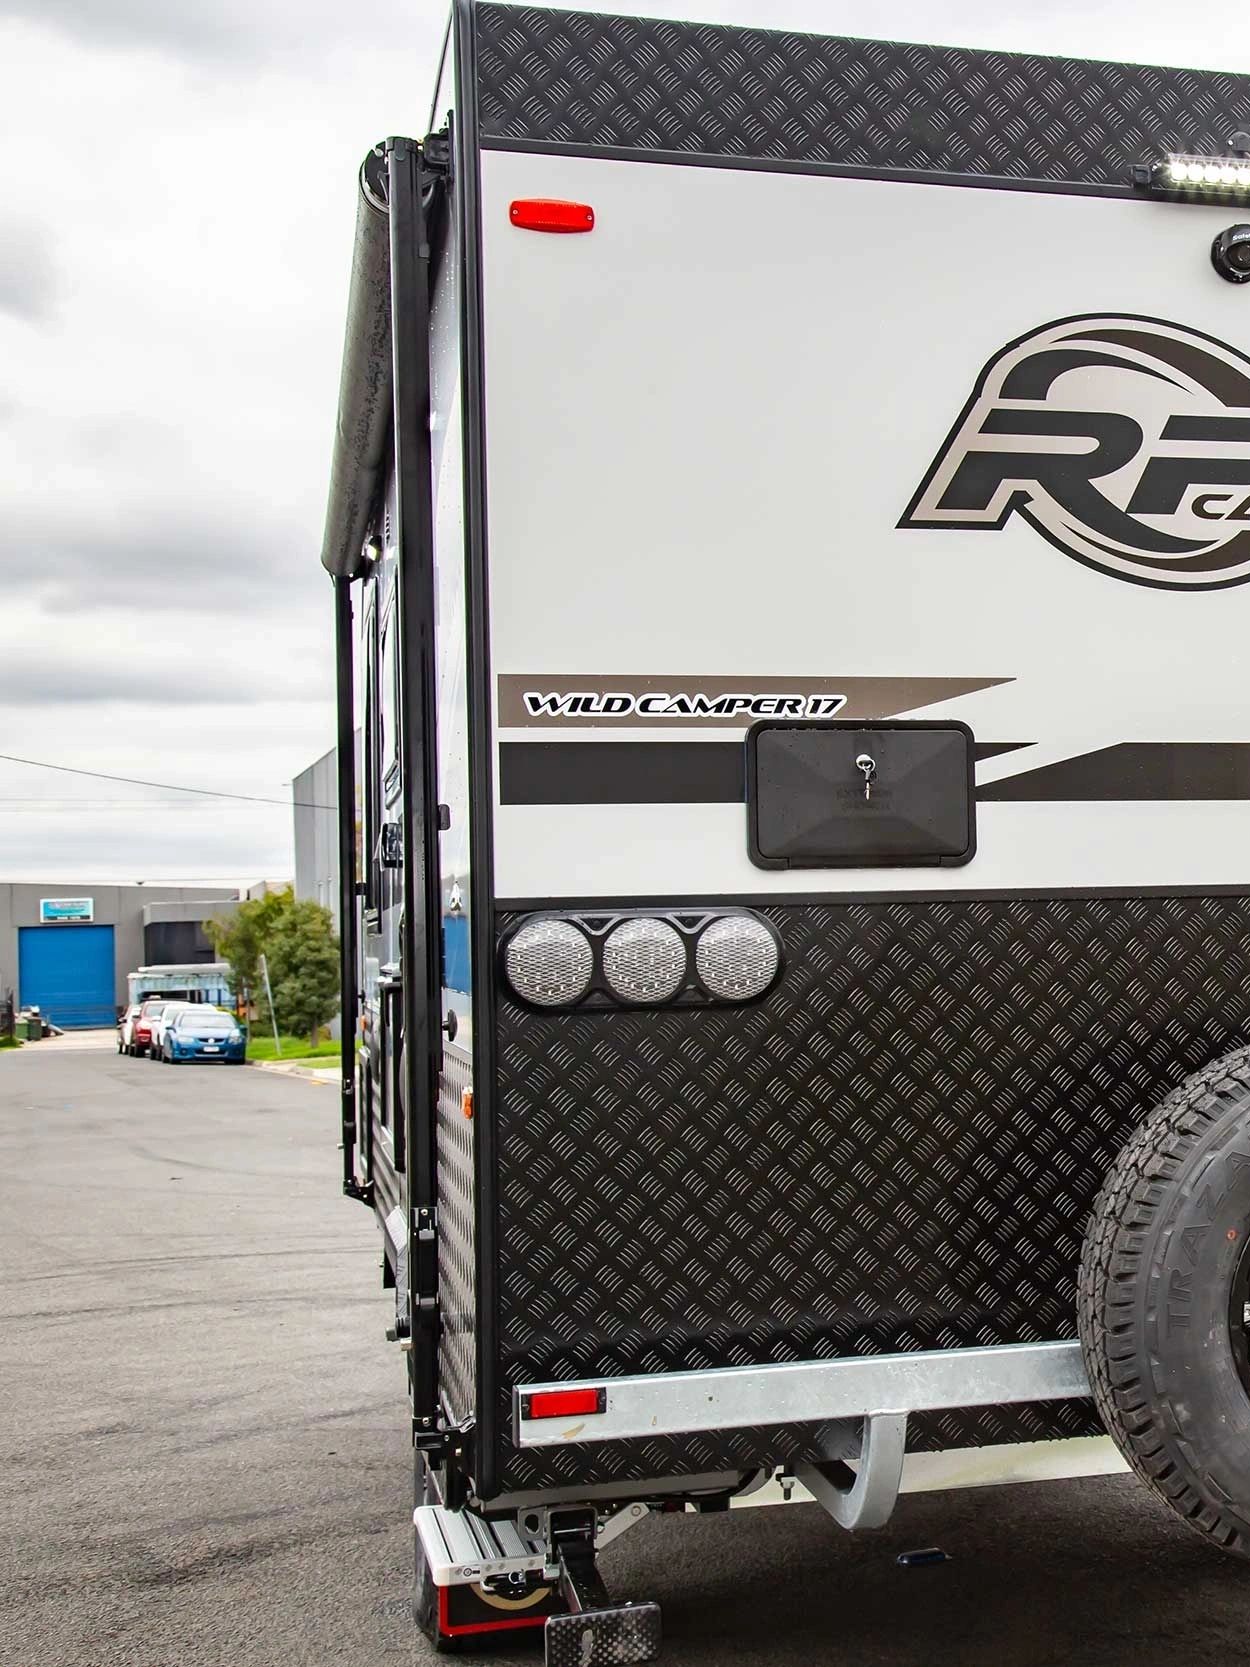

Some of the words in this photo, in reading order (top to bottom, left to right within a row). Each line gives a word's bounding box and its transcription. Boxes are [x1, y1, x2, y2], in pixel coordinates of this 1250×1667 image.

[525, 695, 636, 715] WILD
[640, 697, 803, 715] CAMPER
[805, 697, 845, 716] 17
